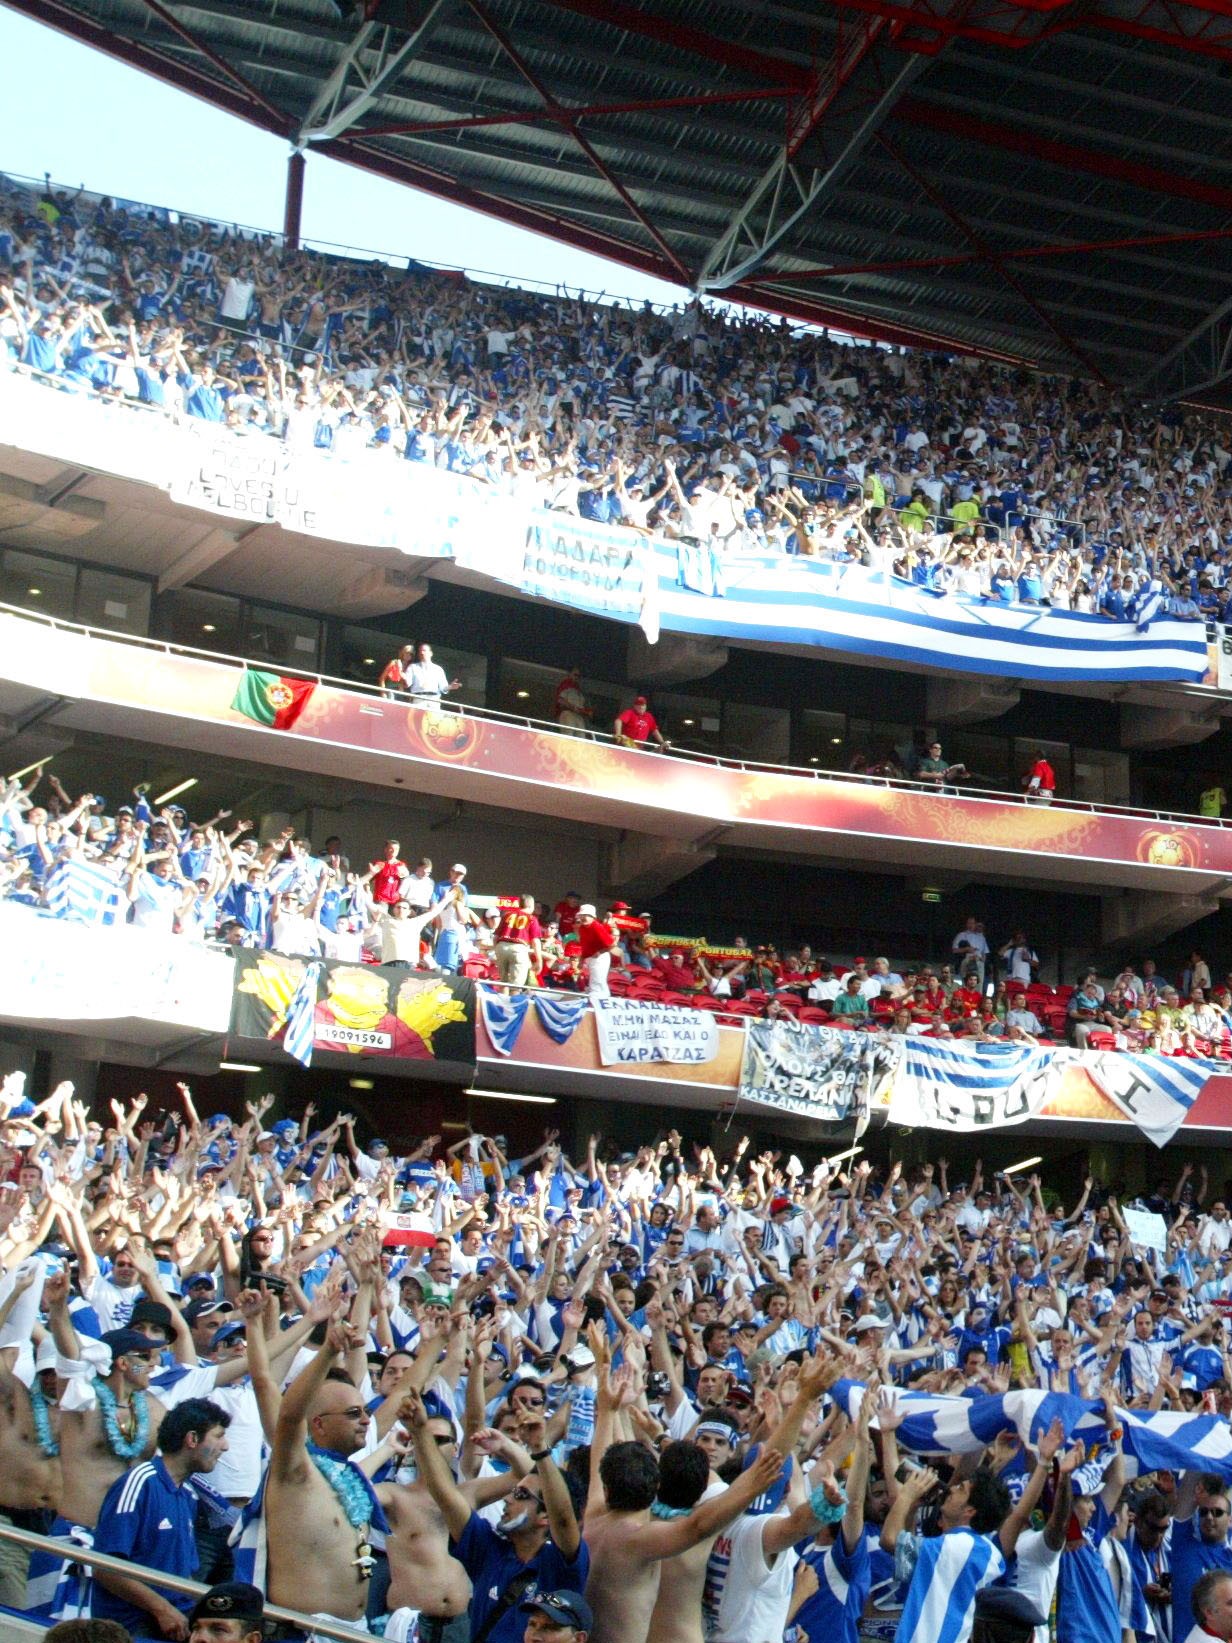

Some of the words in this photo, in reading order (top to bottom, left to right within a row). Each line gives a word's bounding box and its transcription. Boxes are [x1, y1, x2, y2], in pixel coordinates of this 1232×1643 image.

[505, 912, 529, 930] 10
[699, 946, 753, 957] PORTUGAL
[673, 1030, 696, 1041] ΚΑΙ
